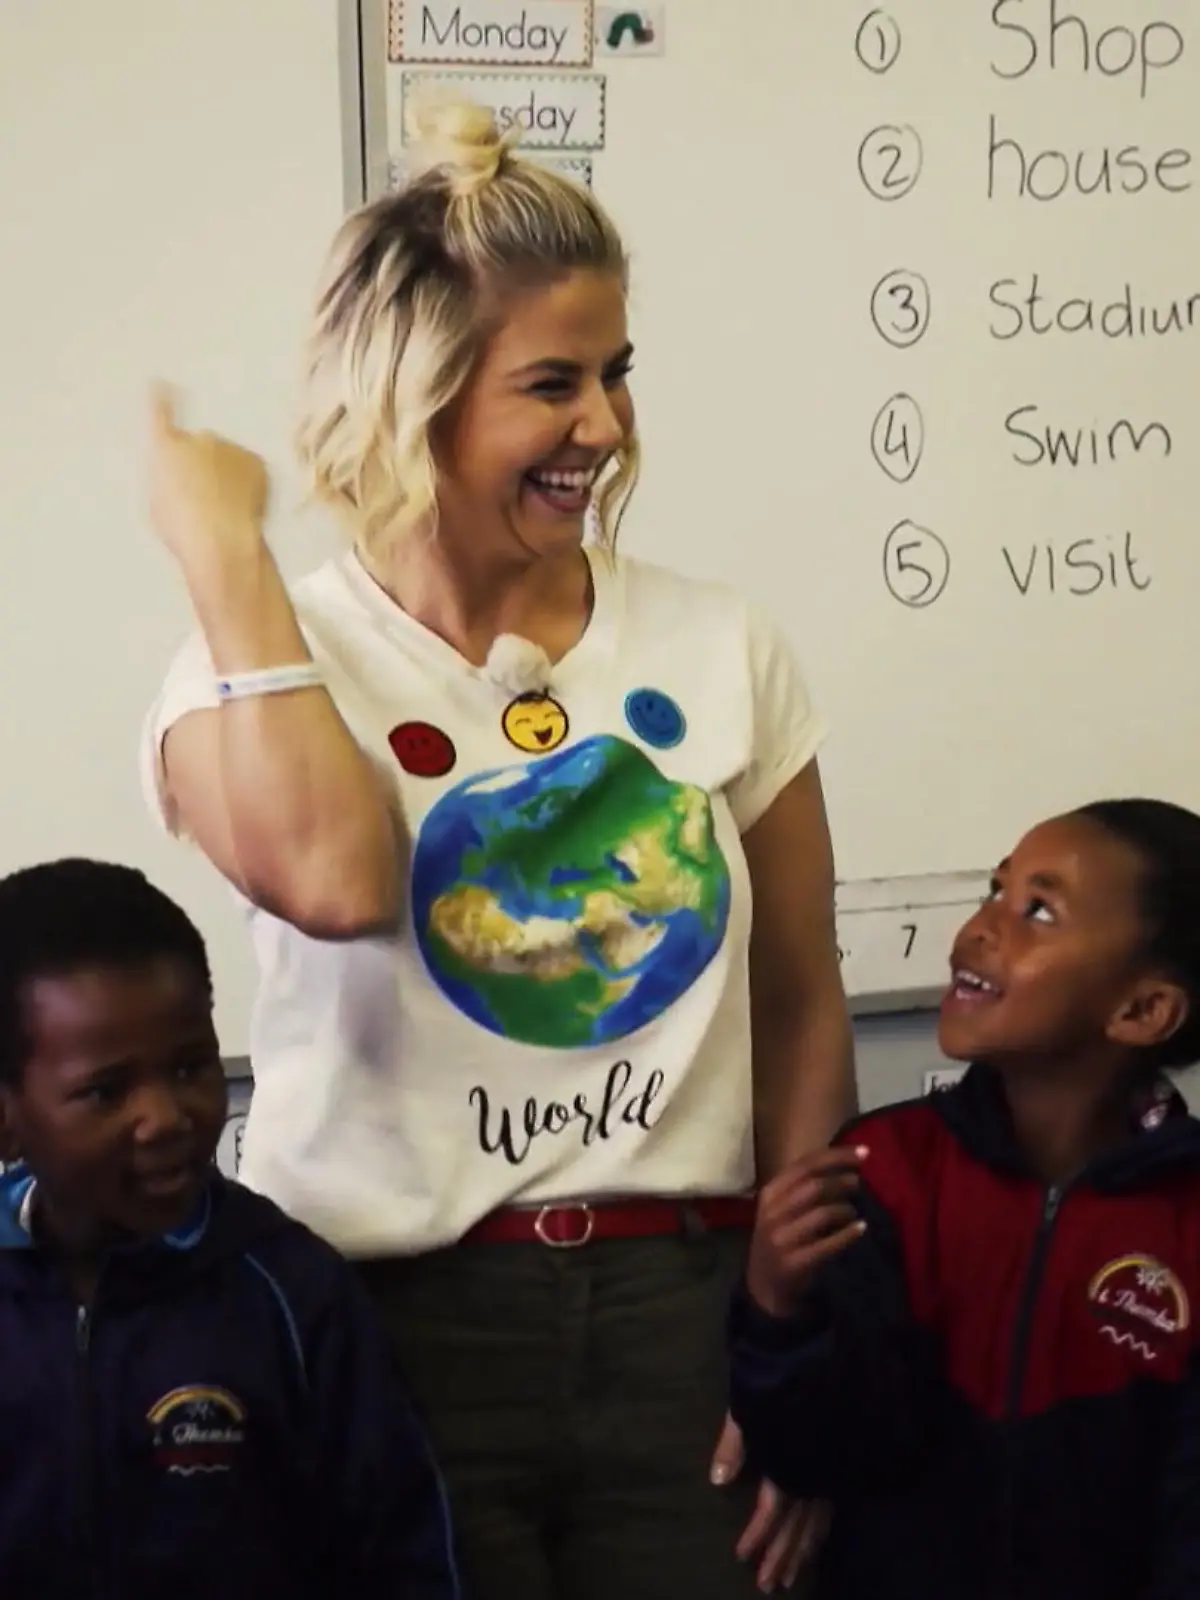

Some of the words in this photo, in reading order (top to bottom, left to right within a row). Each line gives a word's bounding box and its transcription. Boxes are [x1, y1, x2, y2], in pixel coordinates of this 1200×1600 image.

[421, 5, 569, 61] Monday
[990, 0, 1184, 99] Shop
[491, 89, 577, 144] sday
[987, 113, 1192, 201] house
[1004, 404, 1172, 467] Swim
[901, 923, 918, 959] 7
[468, 1059, 665, 1166] World
